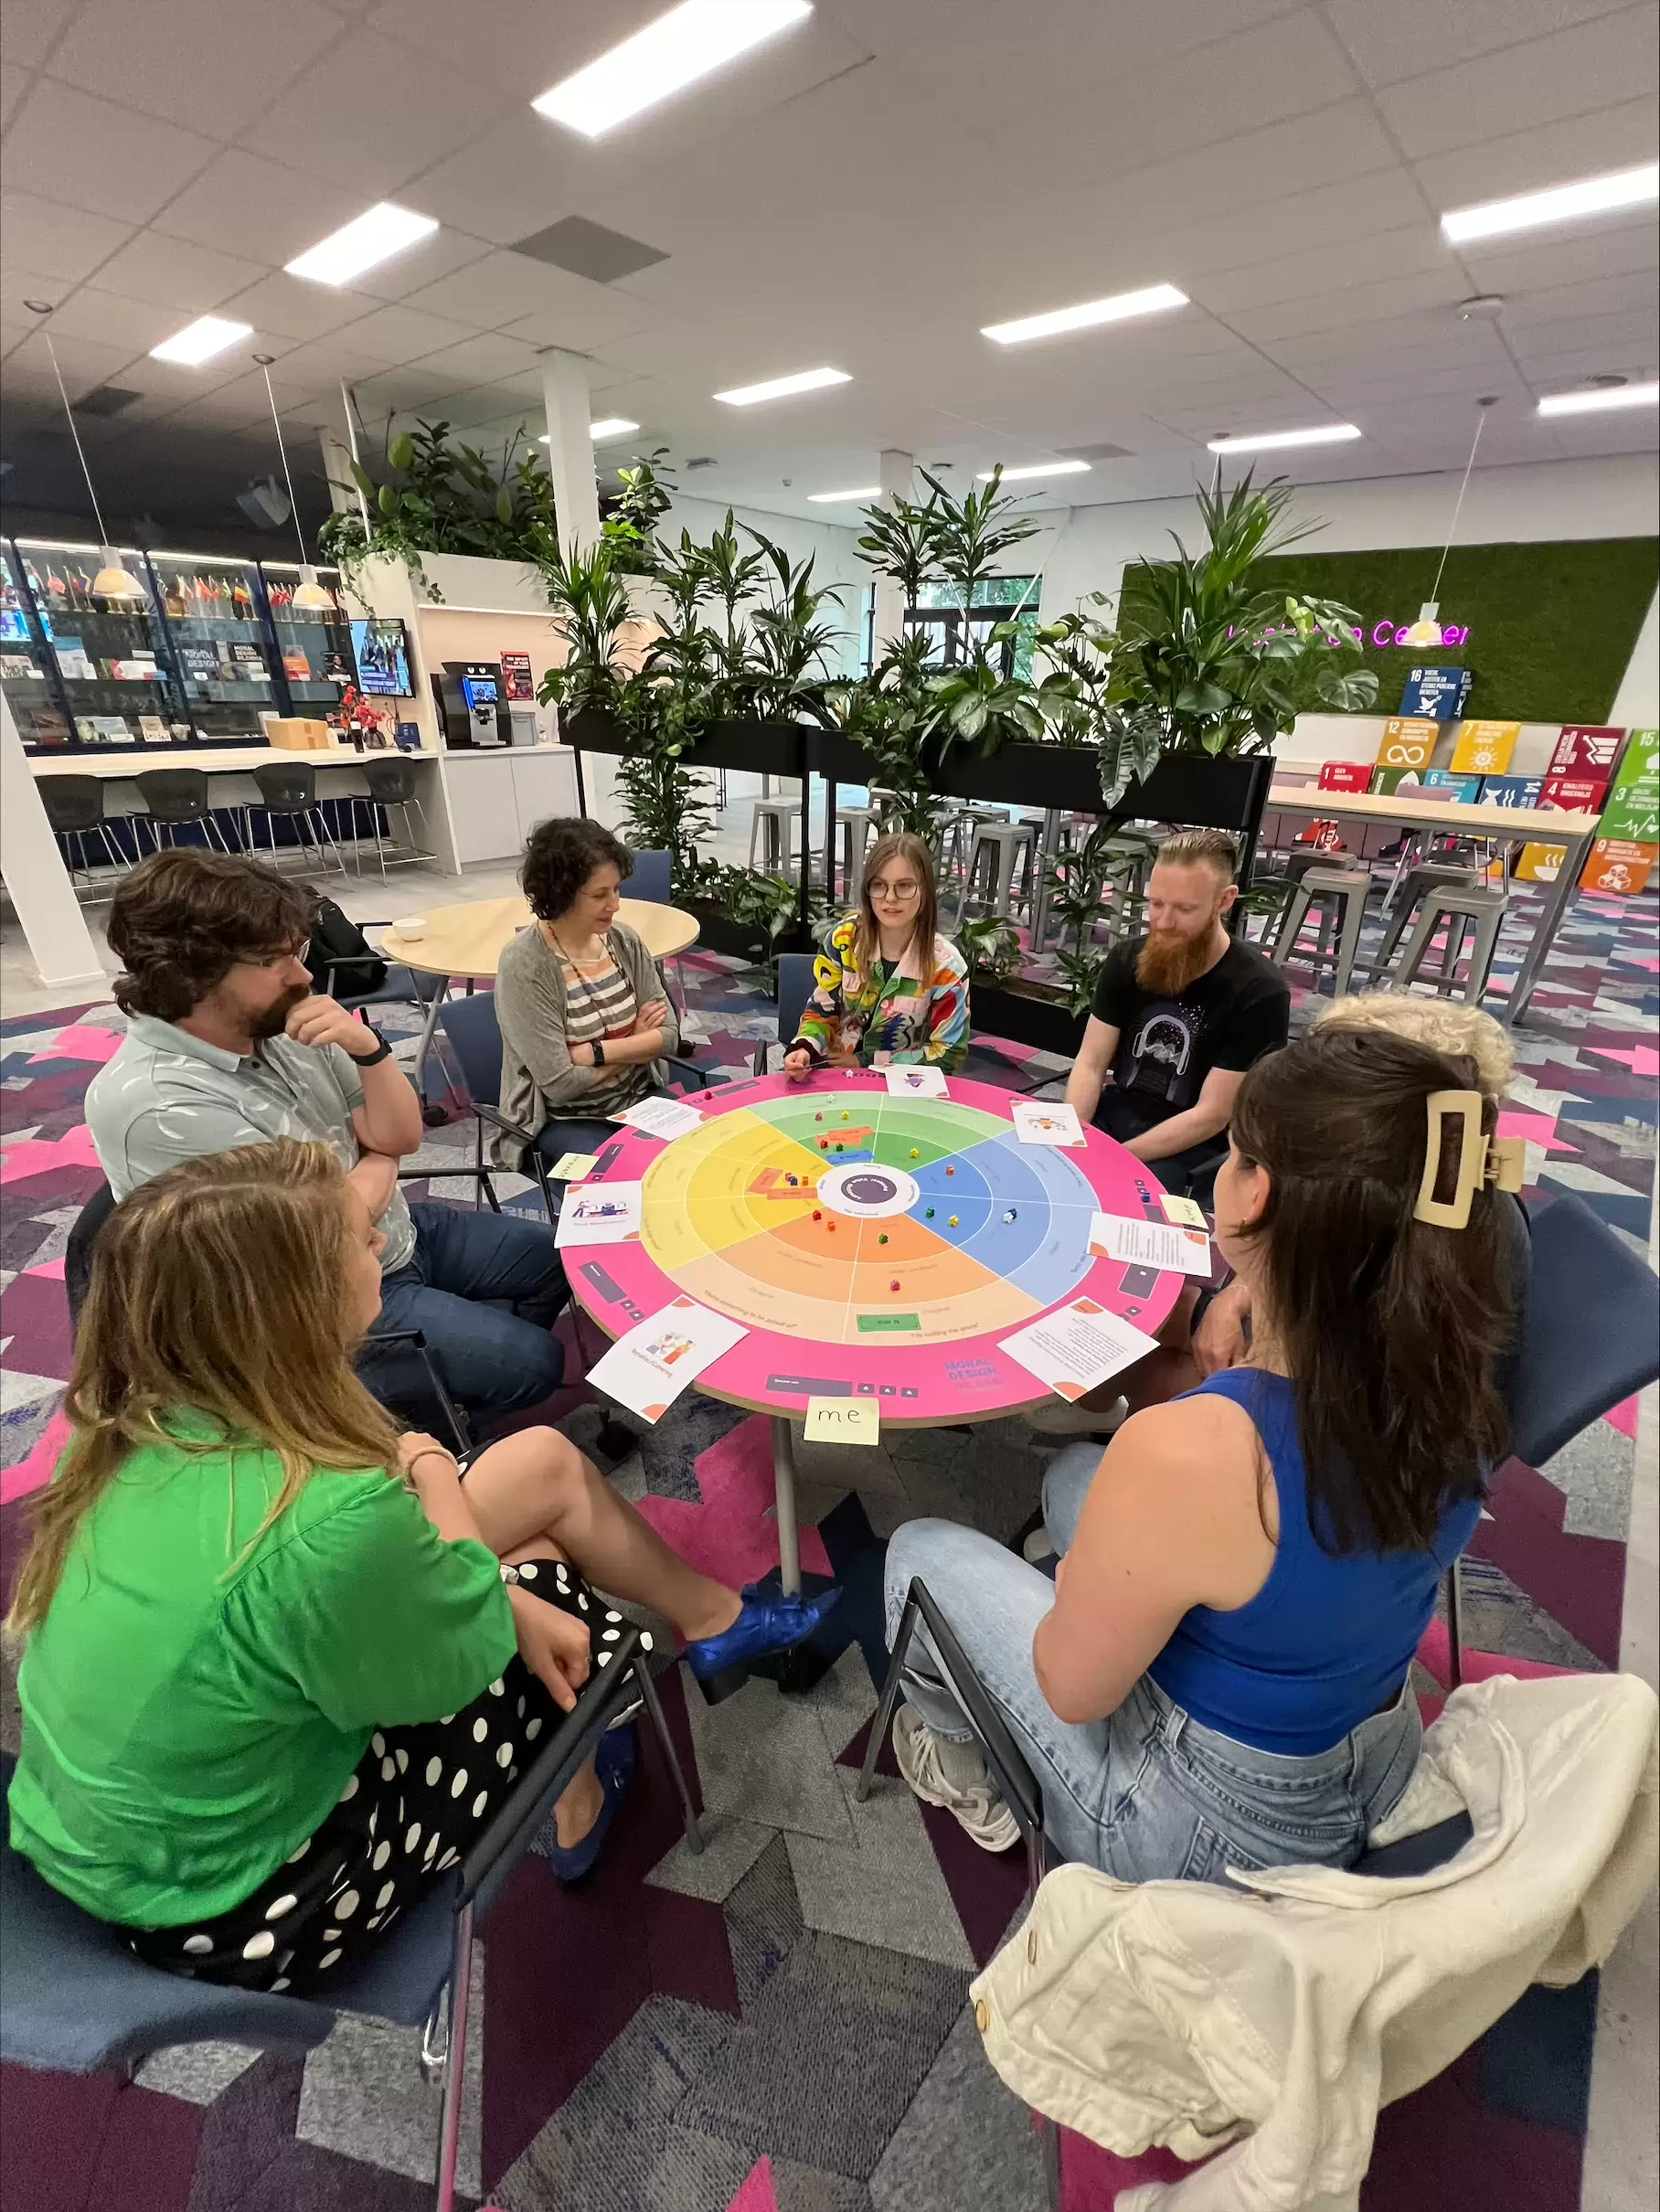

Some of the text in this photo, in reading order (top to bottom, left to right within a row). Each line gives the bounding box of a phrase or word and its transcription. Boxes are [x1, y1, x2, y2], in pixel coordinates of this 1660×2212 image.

[1372, 620, 1468, 648] Ceer
[1410, 669, 1423, 682] 16
[1389, 721, 1399, 734] 12
[1465, 723, 1474, 736] 7
[1640, 732, 1656, 746] 15
[1325, 767, 1330, 780] 1
[1431, 773, 1438, 785] 6
[1524, 782, 1541, 793] 14
[1548, 782, 1558, 795] 4
[1615, 787, 1627, 801] 3
[1597, 839, 1607, 852] 9
[817, 1409, 862, 1424] me
